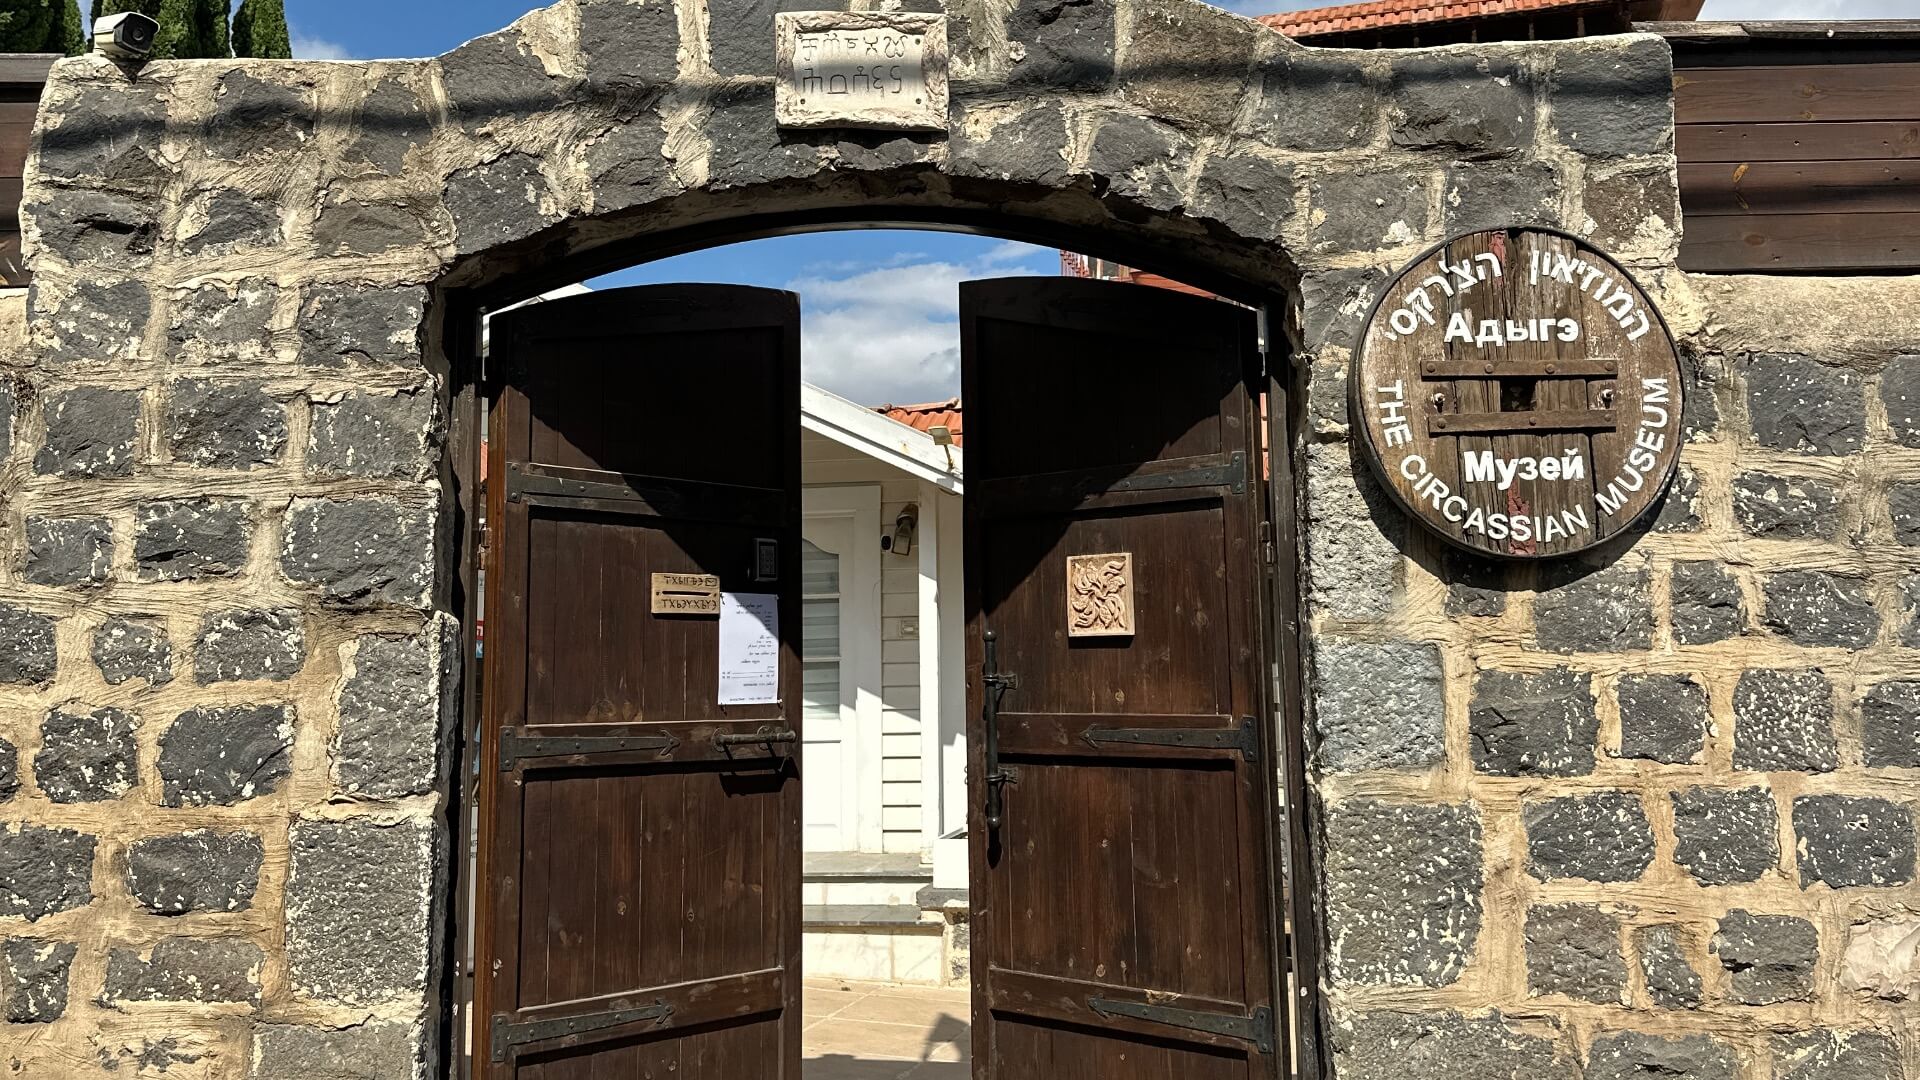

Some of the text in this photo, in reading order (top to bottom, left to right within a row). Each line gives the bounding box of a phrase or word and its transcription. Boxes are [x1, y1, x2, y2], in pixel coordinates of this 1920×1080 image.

[1530, 249, 1650, 341] המוזיאון
[1443, 312, 1579, 348] Адыгэ
[1377, 378, 1670, 543] THE CIRCASSIAN MUSEUM
[1463, 448, 1584, 490] Музей
